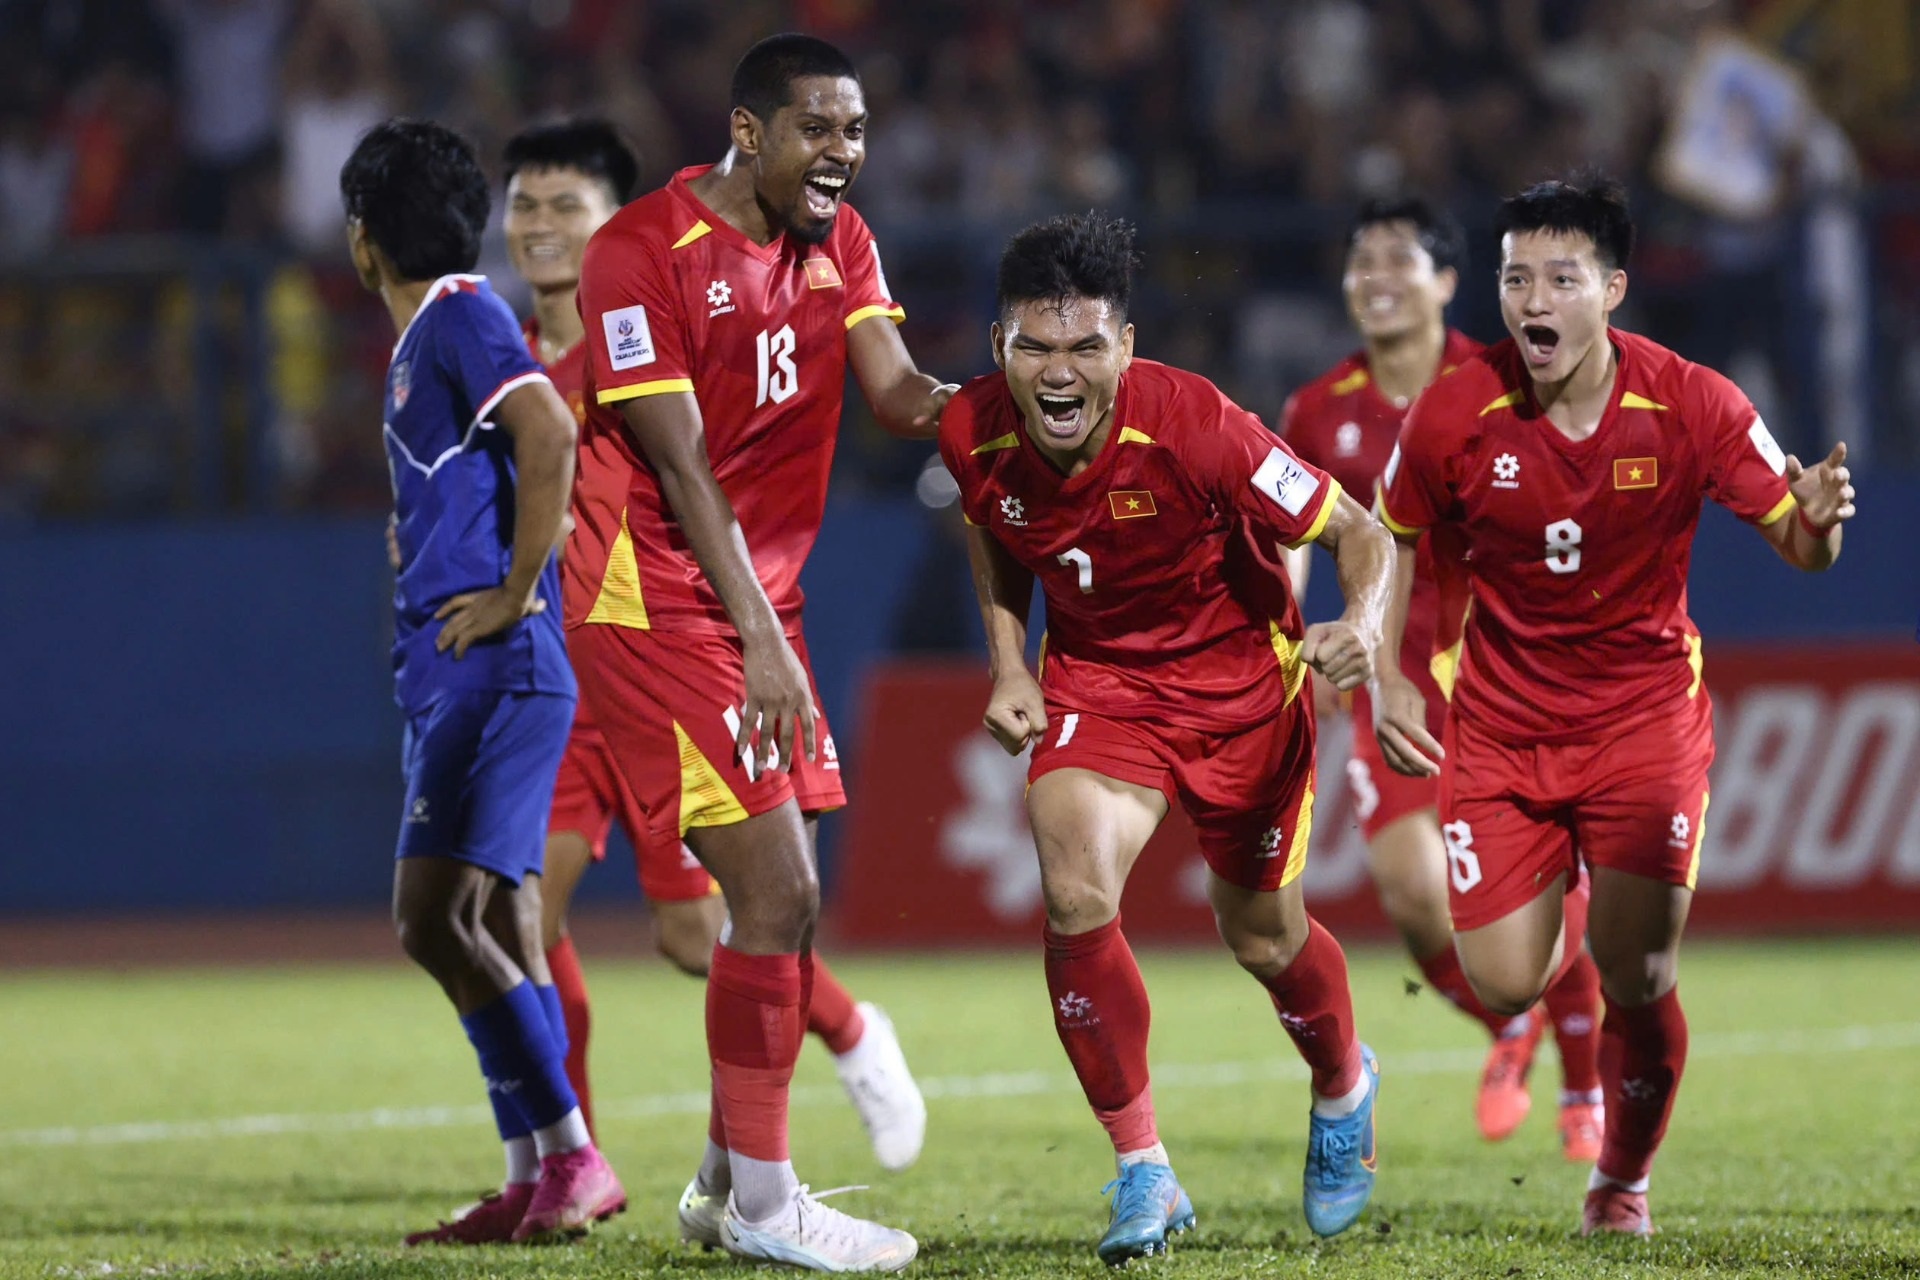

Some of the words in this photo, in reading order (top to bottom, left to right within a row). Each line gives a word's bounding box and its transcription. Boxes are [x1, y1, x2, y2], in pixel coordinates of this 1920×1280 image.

[615, 348, 650, 361] QUALIFIERS
[756, 323, 799, 408] 13
[1275, 462, 1298, 497] AFC
[1056, 547, 1095, 594] 7
[1544, 517, 1582, 574] 8
[1443, 818, 1483, 895] 8
